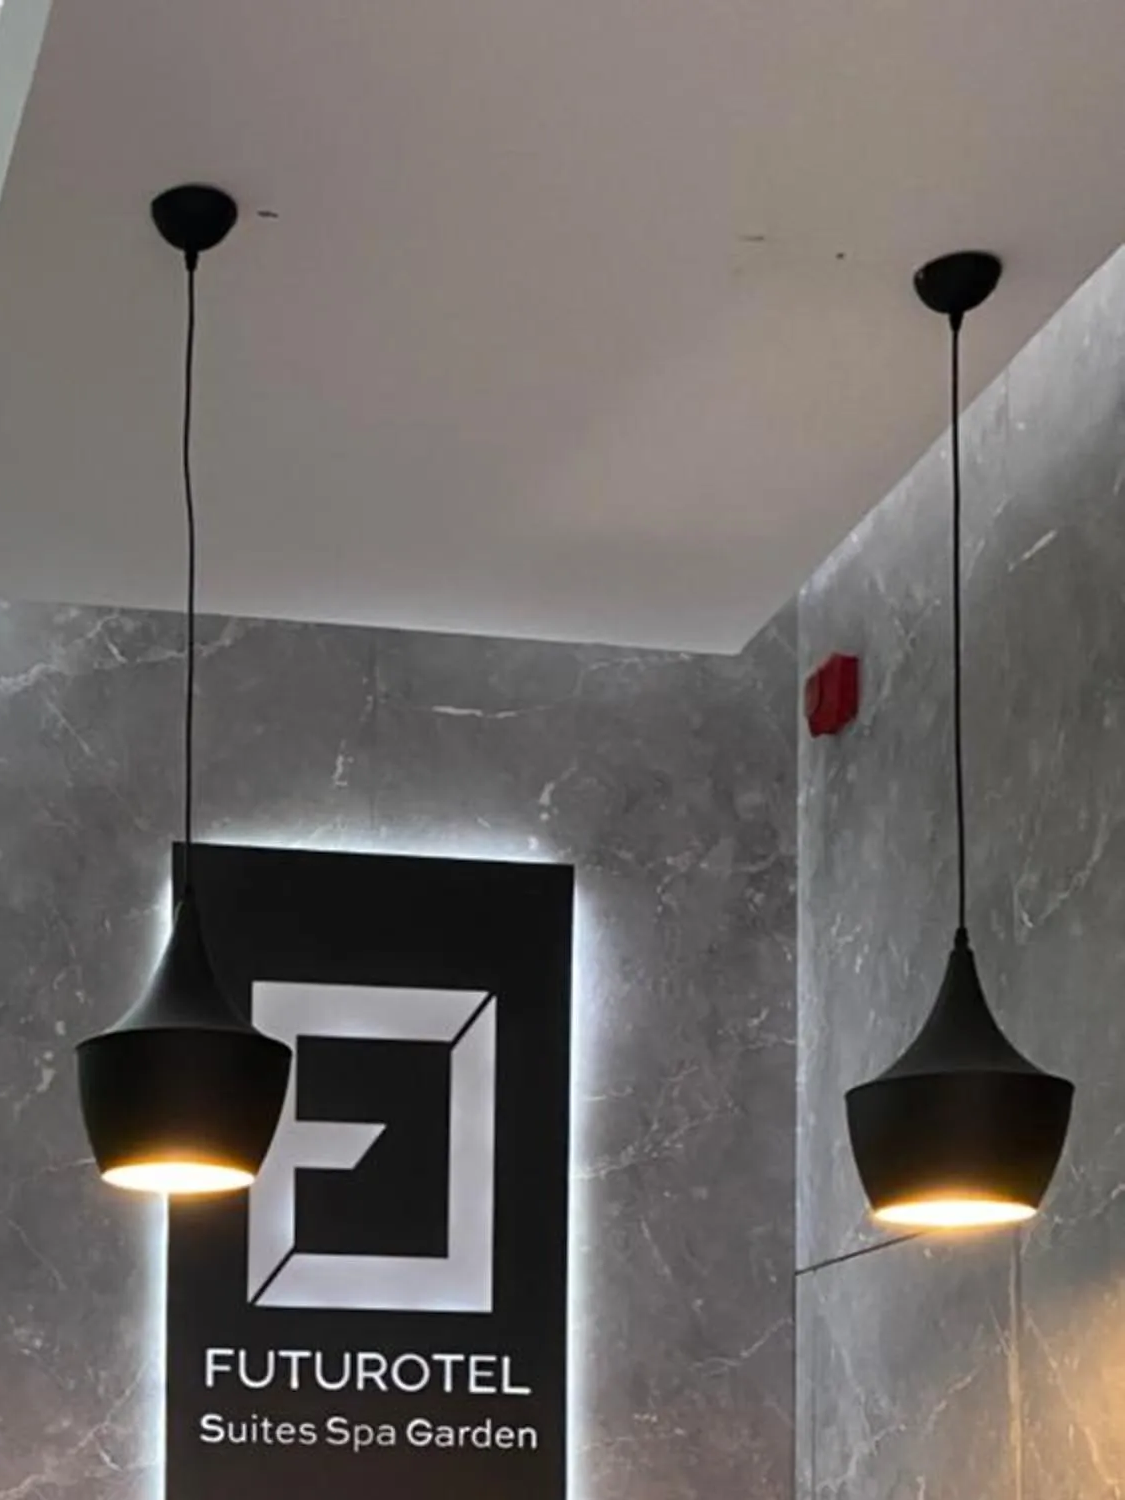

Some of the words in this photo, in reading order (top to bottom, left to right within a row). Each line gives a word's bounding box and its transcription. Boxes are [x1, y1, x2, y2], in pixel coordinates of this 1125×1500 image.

[204, 1347, 532, 1395] FUTUROTEL
[199, 1412, 318, 1445] Suites
[325, 1416, 397, 1453] Spa
[405, 1417, 539, 1450] Garden
